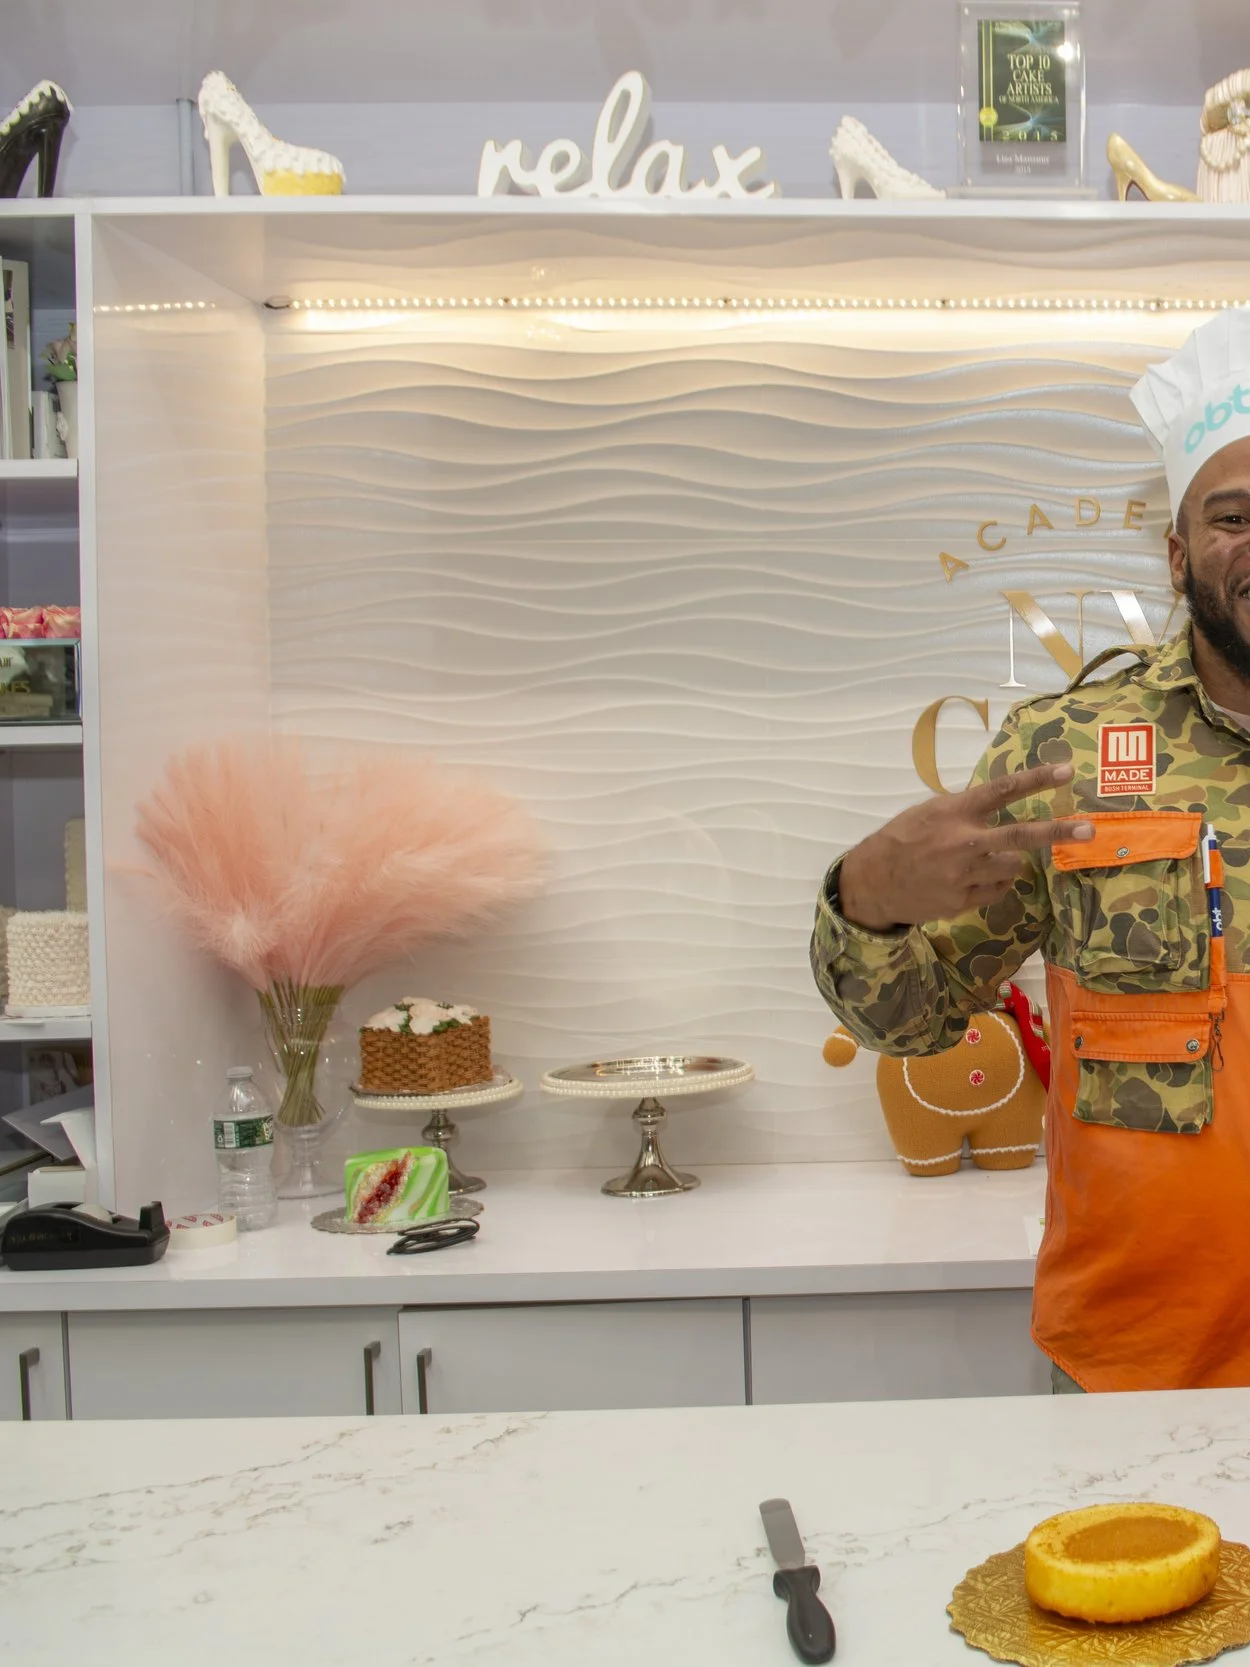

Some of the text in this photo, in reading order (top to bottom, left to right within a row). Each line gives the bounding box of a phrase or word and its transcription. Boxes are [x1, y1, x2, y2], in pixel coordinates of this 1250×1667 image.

[1007, 54, 1051, 70] TOP 10
[1012, 70, 1044, 83] CAKE
[1006, 83, 1053, 96] ARTISTS
[1008, 95, 1030, 104] NORTH
[1030, 95, 1060, 105] AMERICA
[477, 70, 782, 198] relax
[939, 496, 1175, 583] ACADE
[1104, 769, 1150, 782] MADE
[1121, 784, 1150, 792] TERMINAL
[1212, 907, 1223, 931] obt
